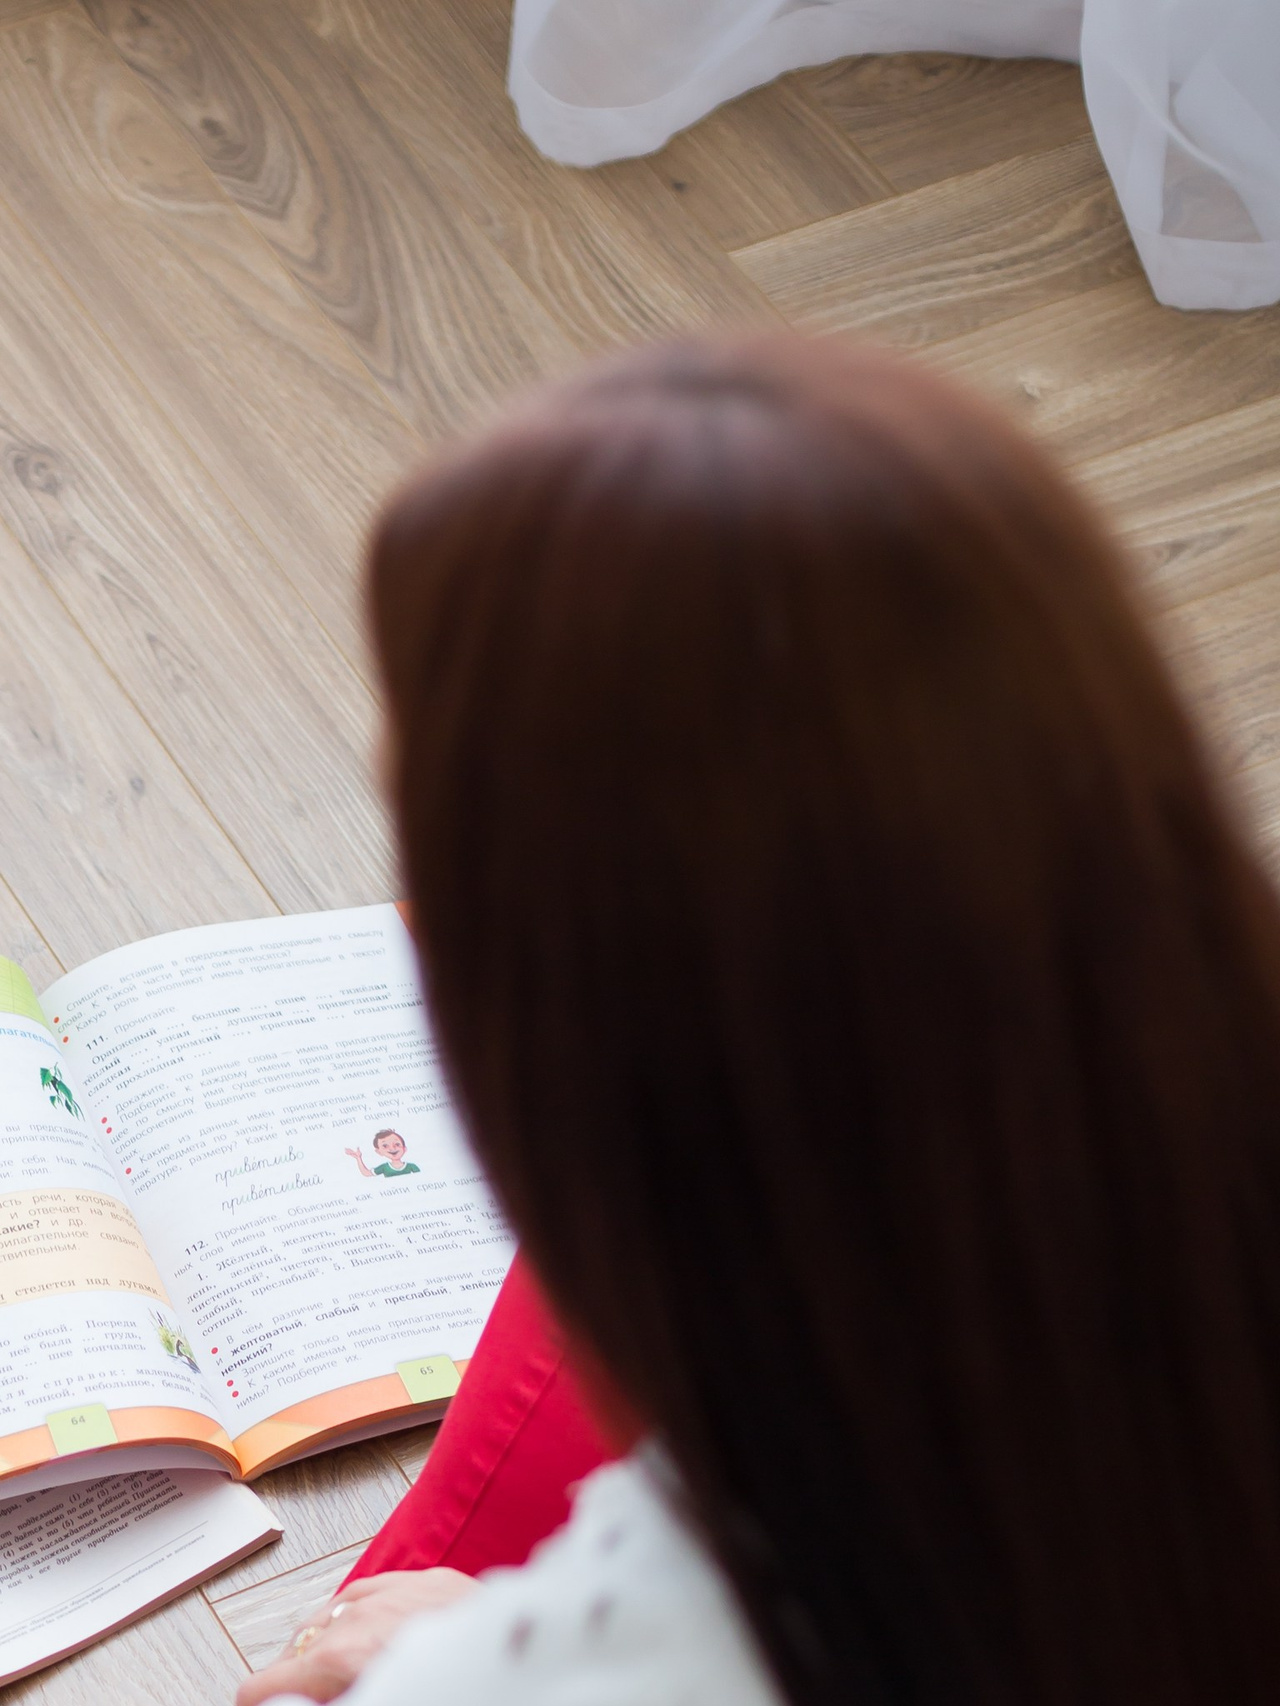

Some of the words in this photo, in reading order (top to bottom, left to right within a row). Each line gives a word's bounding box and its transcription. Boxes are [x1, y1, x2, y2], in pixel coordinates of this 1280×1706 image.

[49, 1218, 59, 1226] и
[68, 1217, 87, 1230] др.
[14, 1279, 76, 1296] стелется
[85, 1277, 110, 1286] над
[118, 1278, 161, 1296] лугами.
[214, 1357, 223, 1366] и
[229, 1320, 306, 1357] желтоватый,
[314, 1304, 360, 1321] слабый
[367, 1300, 376, 1308] и
[383, 1287, 451, 1305] преслабый,
[220, 1342, 272, 1377] ненький?
[419, 1365, 434, 1375] 65
[70, 1414, 86, 1425] 64
